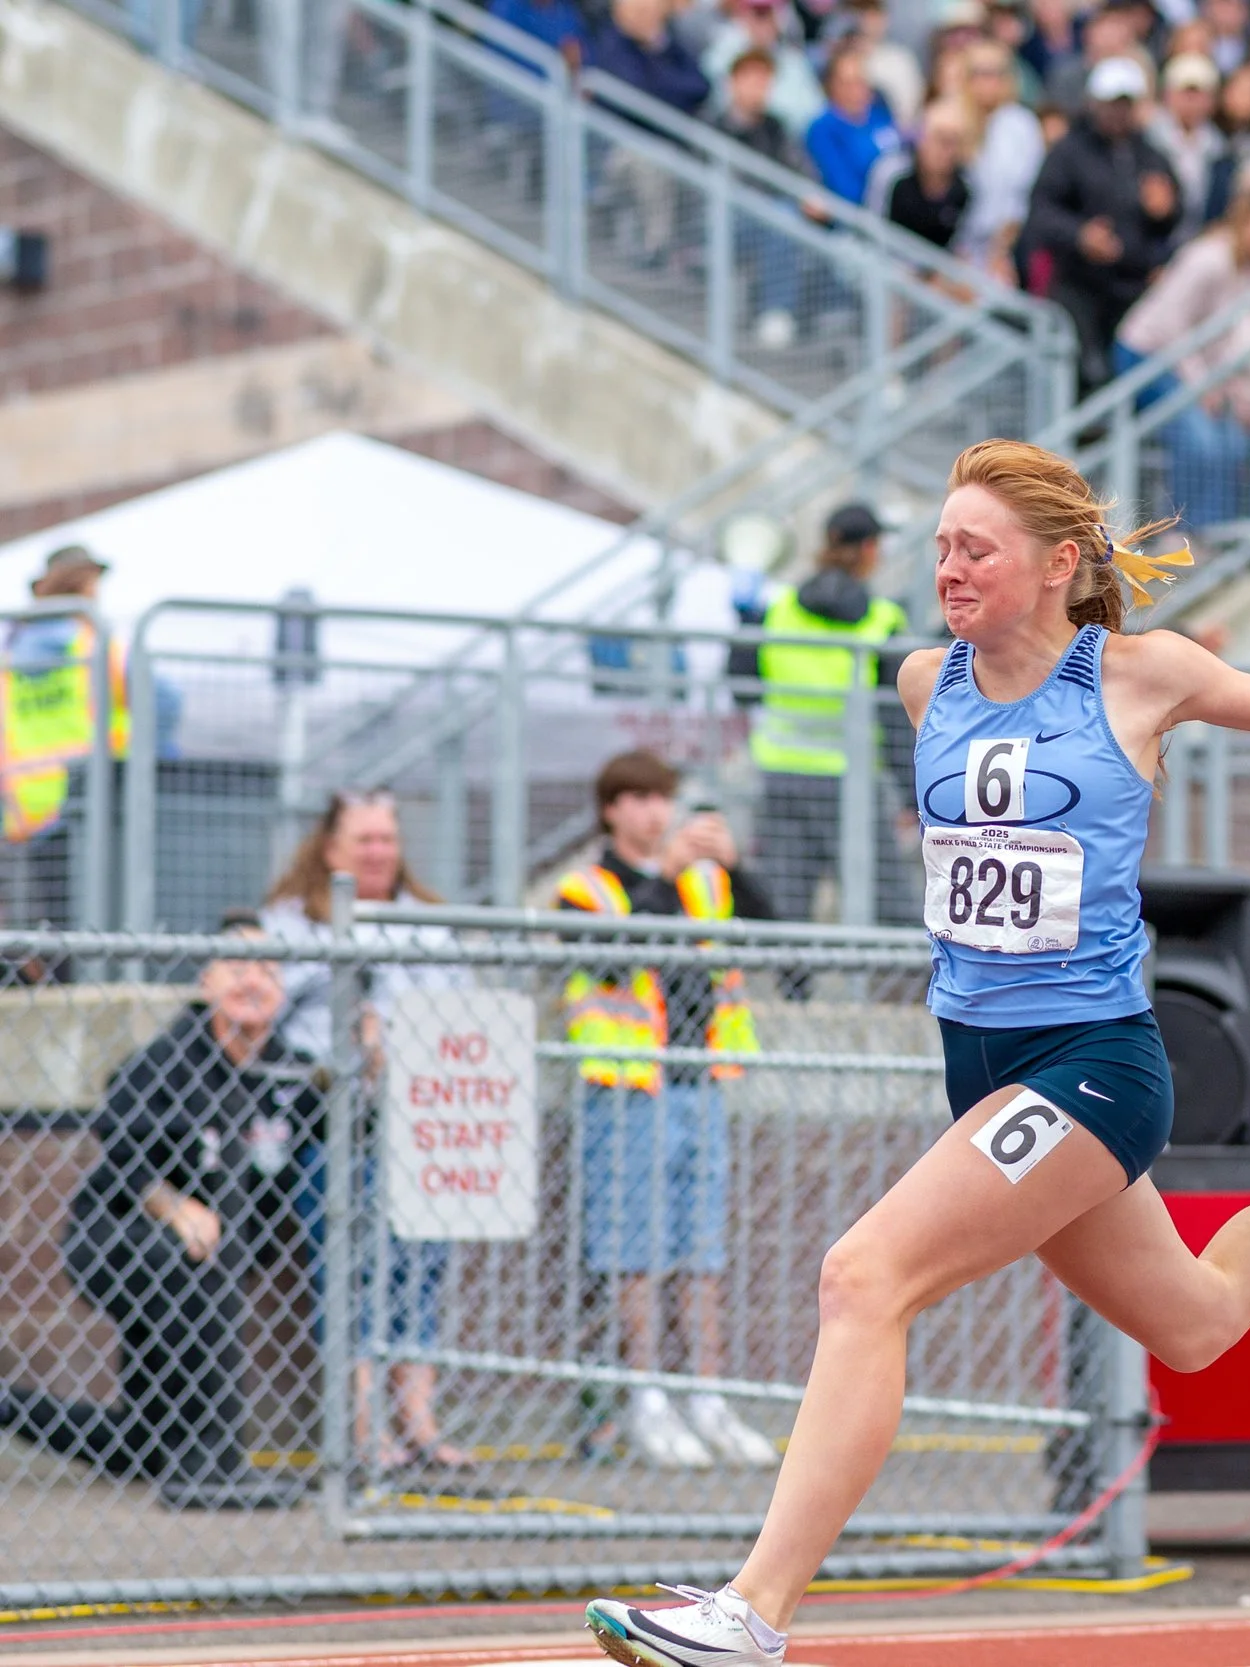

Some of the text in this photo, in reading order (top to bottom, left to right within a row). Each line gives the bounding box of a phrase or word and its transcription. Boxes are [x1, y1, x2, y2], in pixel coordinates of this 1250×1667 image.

[977, 742, 1014, 818] 6
[961, 840, 977, 848] FIELD
[978, 842, 1002, 850] STATE
[1004, 844, 1068, 854] CHAMPIONSHIPS
[981, 828, 1009, 838] 2025
[949, 855, 1043, 930] 829
[438, 1031, 488, 1065] NO
[409, 1075, 516, 1107] ENTRY
[412, 1119, 513, 1152] STAFF
[990, 1105, 1059, 1165] 6
[421, 1163, 504, 1196] ONLY
